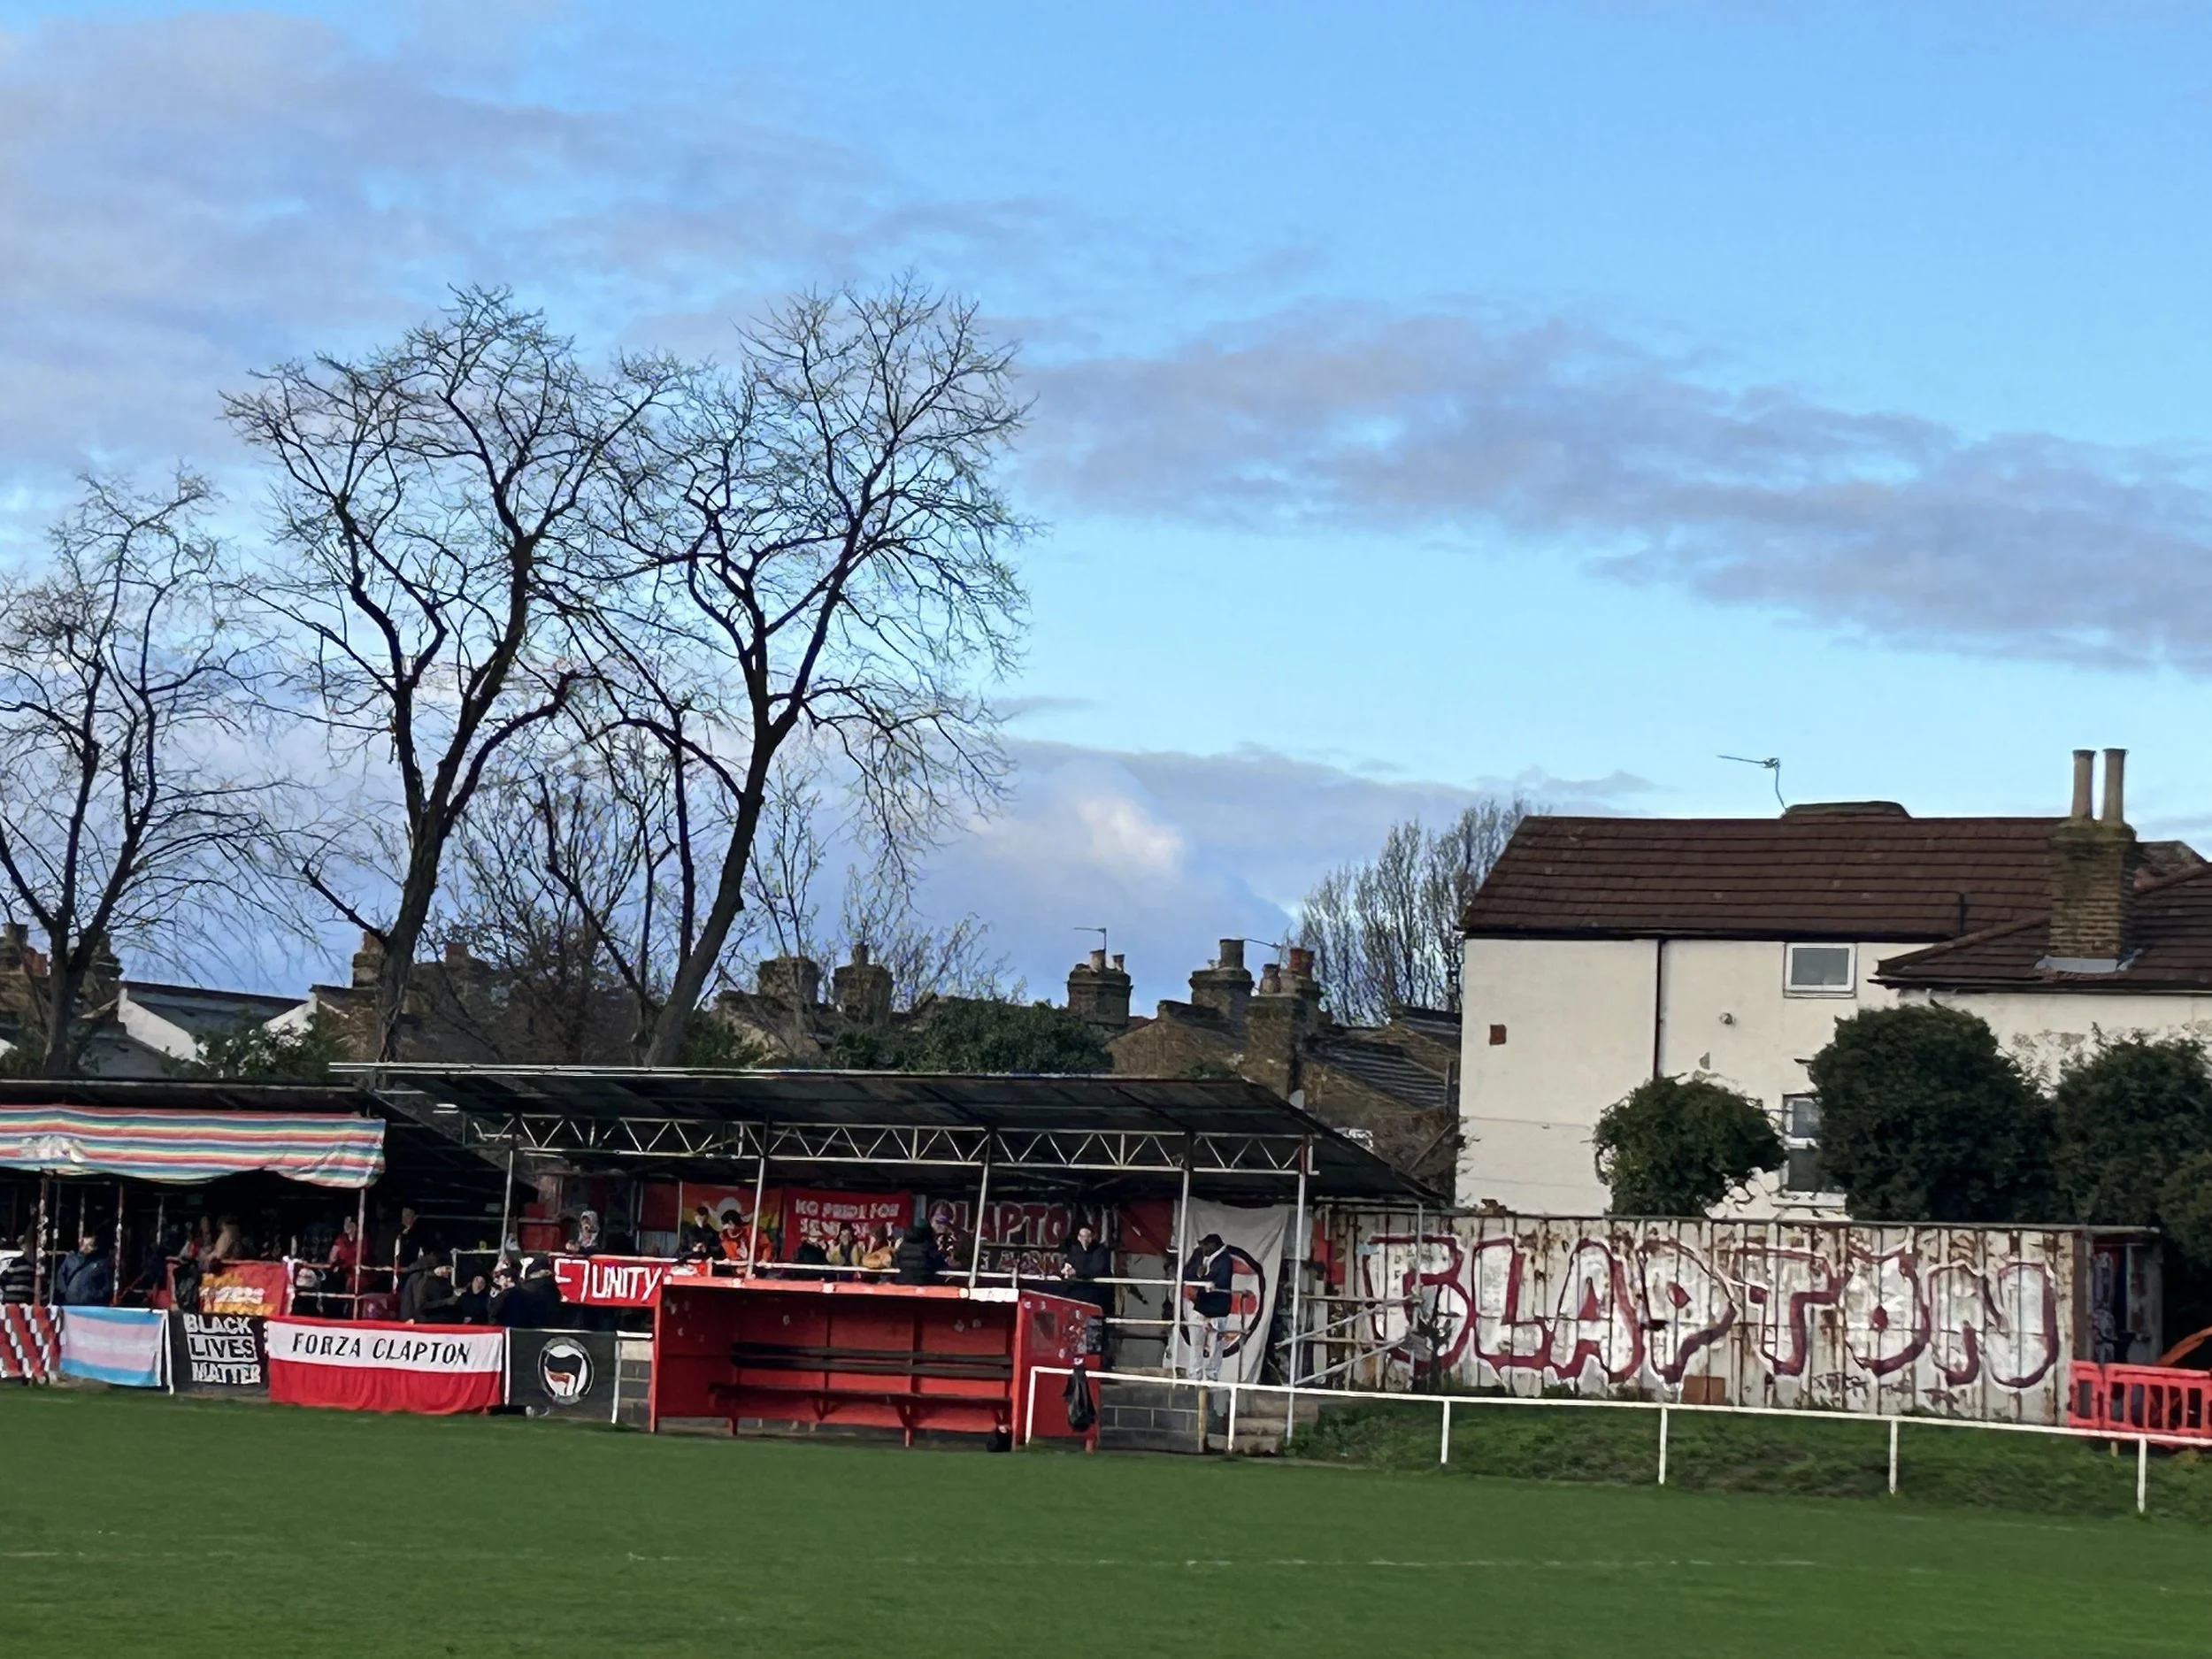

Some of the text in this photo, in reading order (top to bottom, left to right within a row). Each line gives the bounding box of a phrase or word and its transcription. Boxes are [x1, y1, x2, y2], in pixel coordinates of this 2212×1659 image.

[591, 1263, 663, 1302] UNITY
[182, 1313, 253, 1334] BLACK
[188, 1336, 256, 1359] LIVES
[292, 1332, 472, 1365] FORZA CLAPTON
[191, 1362, 262, 1385] MATTER
